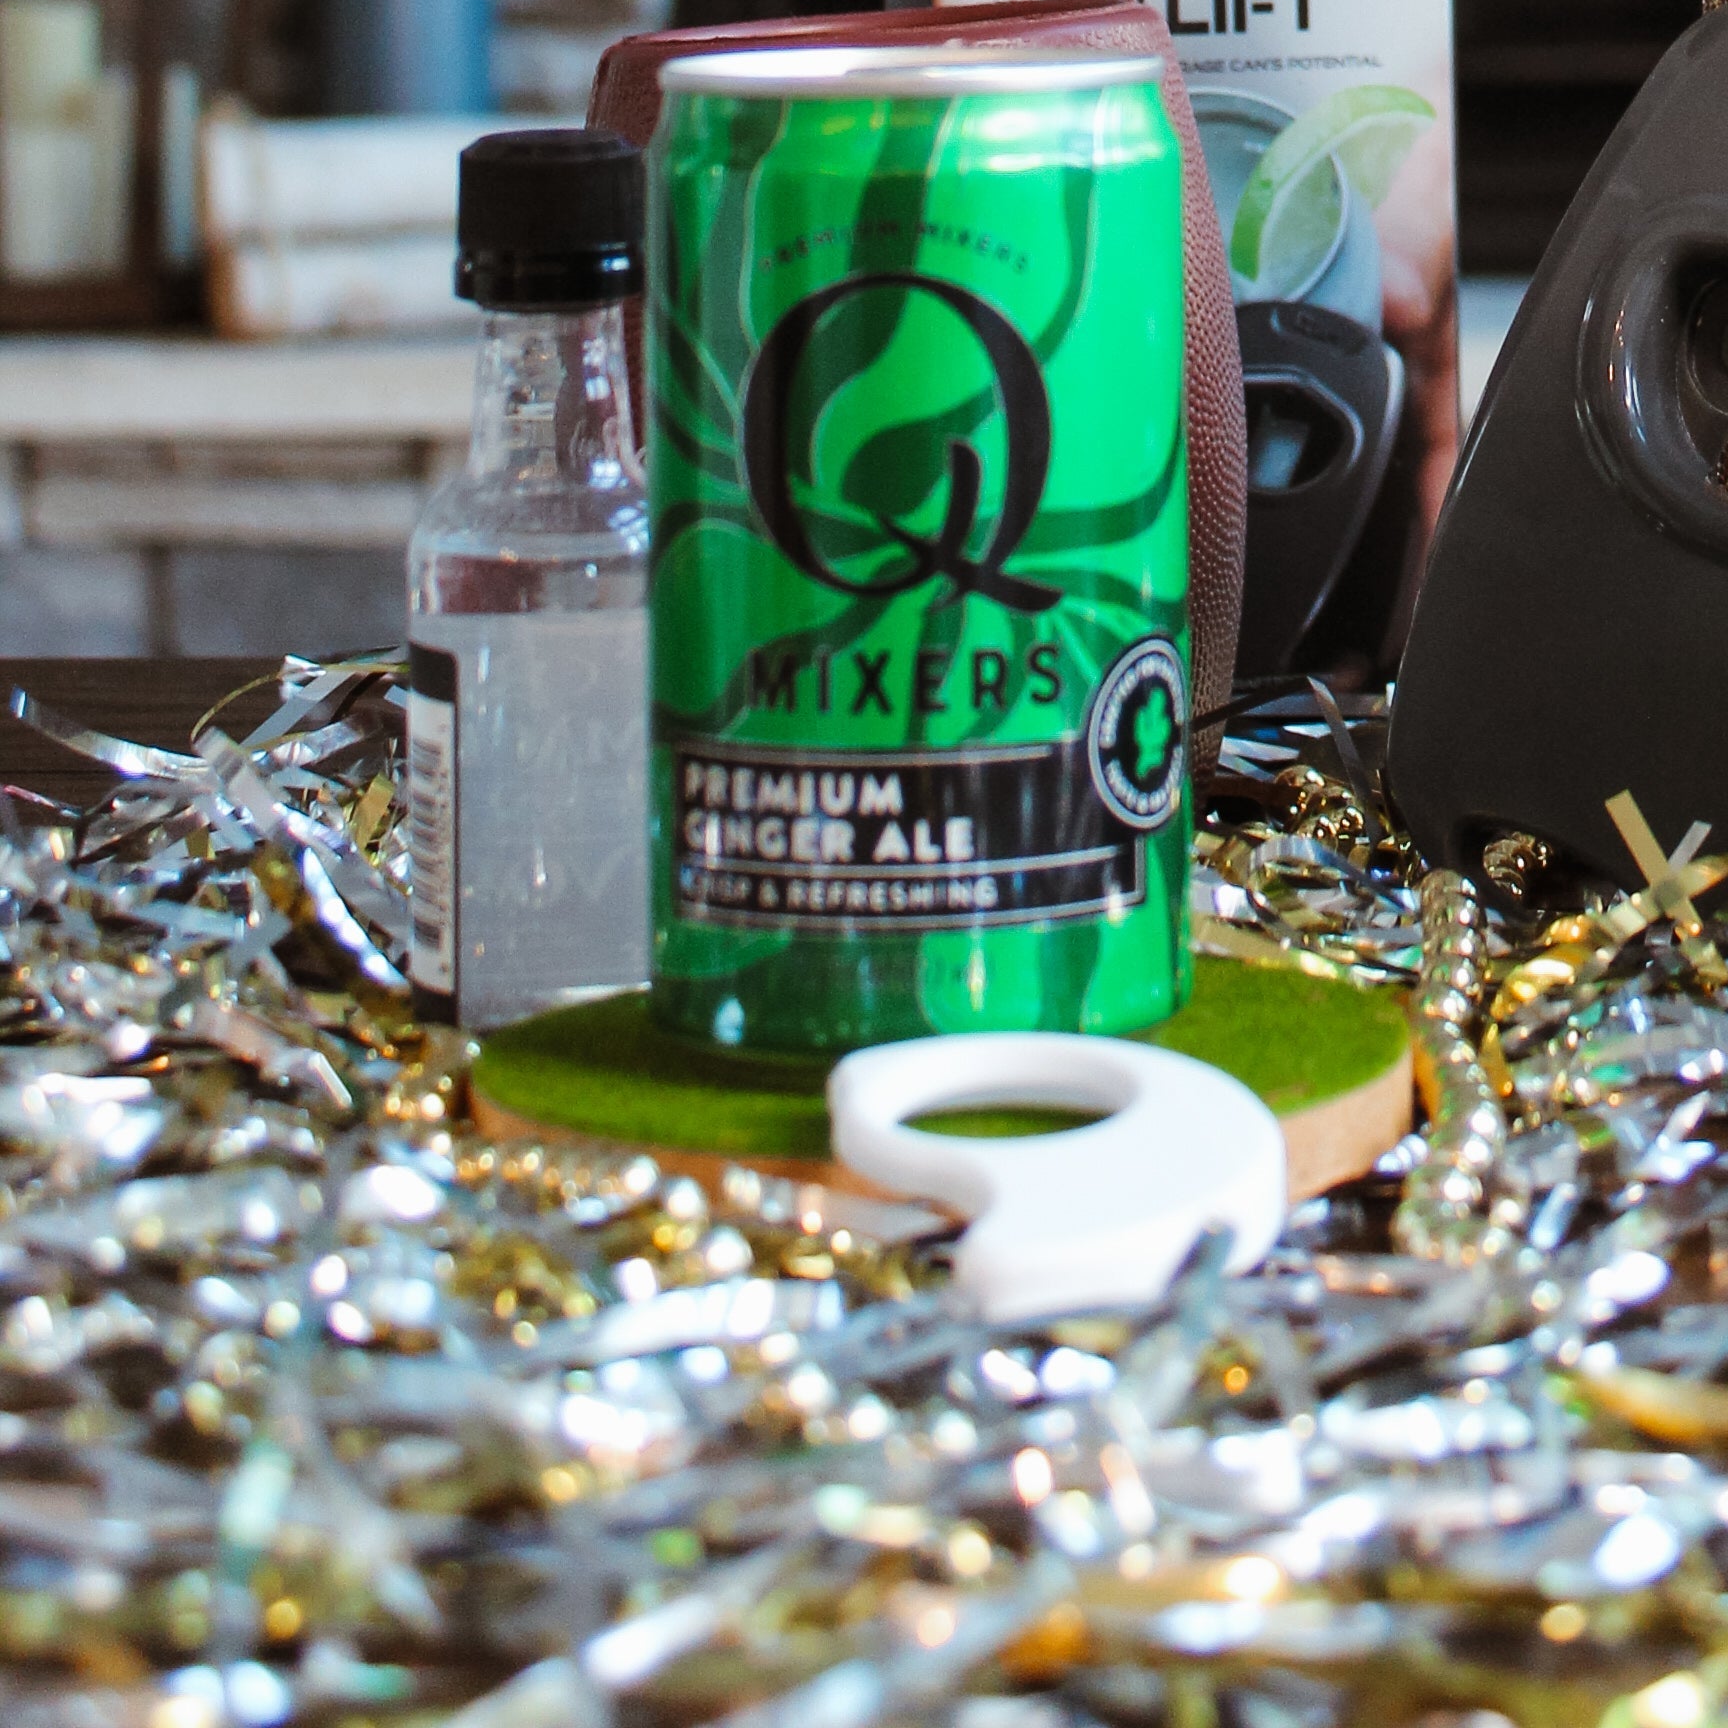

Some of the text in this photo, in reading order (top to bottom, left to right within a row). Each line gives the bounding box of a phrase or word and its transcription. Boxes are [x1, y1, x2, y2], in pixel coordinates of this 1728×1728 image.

[1287, 53, 1384, 72] POTENTIAL
[742, 271, 1064, 614] Q
[748, 642, 1062, 715] MIXERS
[683, 759, 906, 818] PREMIUM
[683, 806, 976, 864] GINGER ALE
[786, 874, 999, 913] REFRESHING
